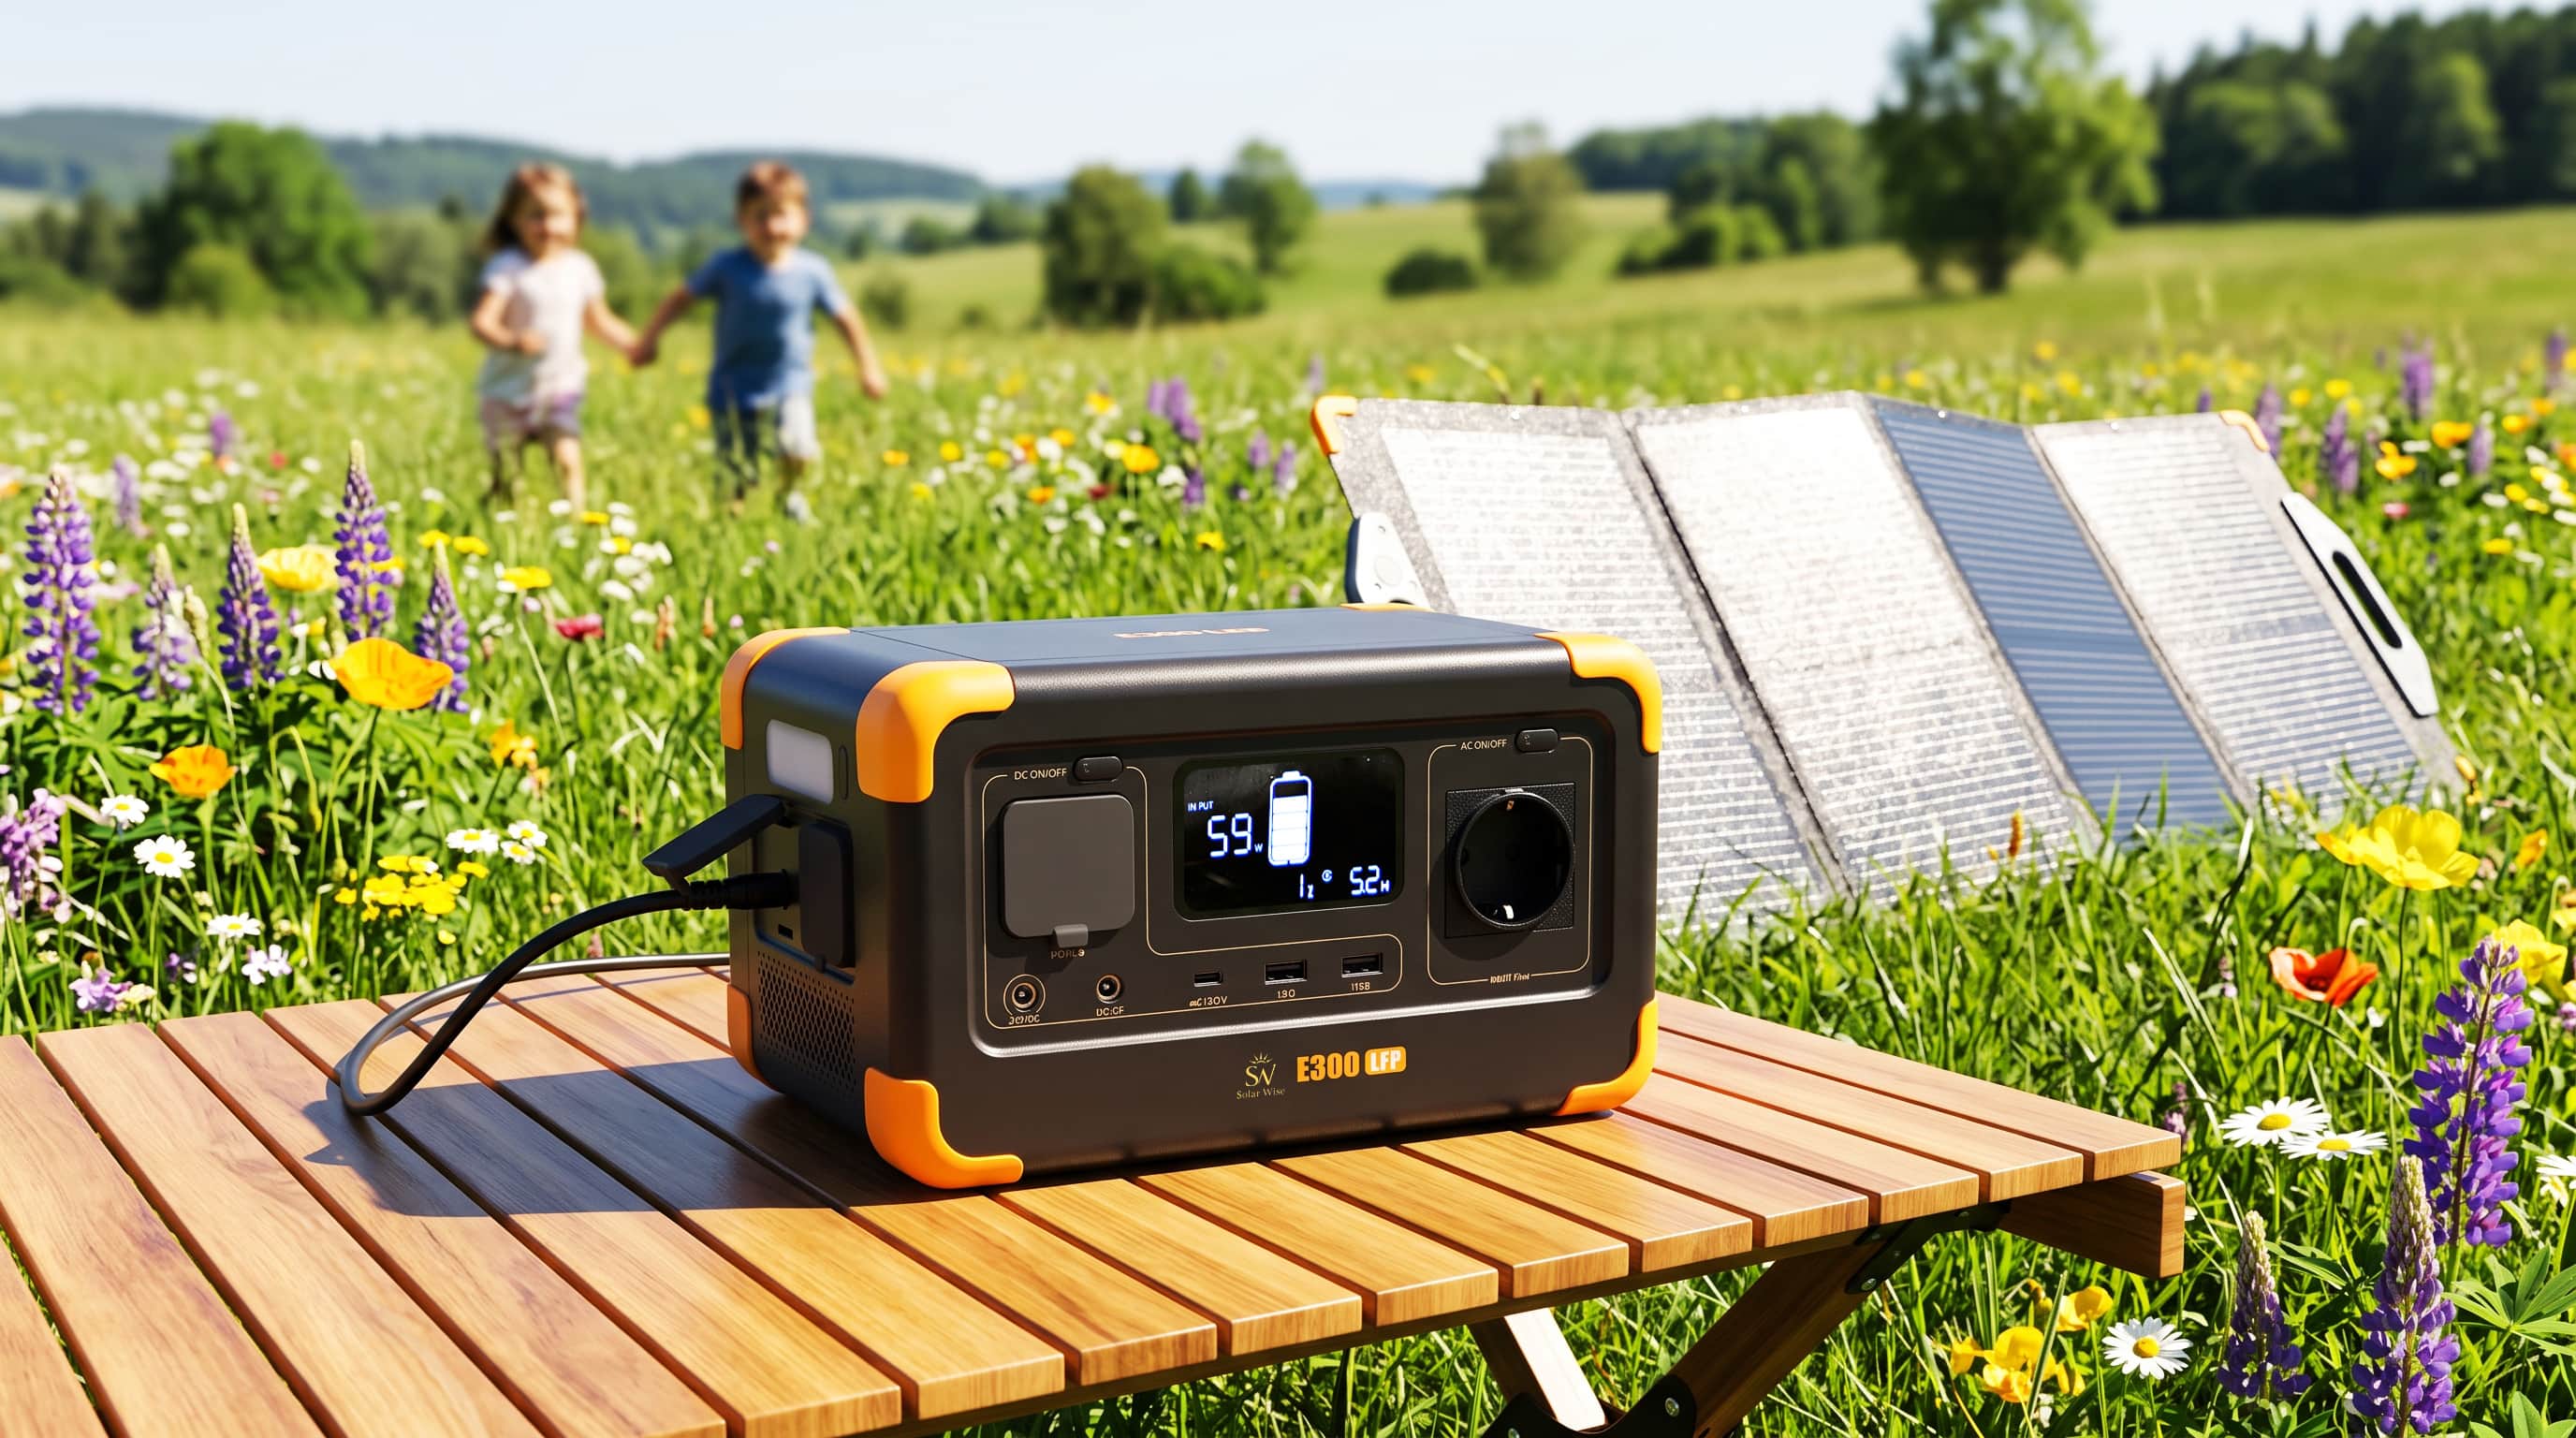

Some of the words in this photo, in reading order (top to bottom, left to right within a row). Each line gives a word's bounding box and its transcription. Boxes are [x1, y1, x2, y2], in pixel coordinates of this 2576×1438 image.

[1460, 741, 1472, 750] AC
[1474, 739, 1507, 750] ON/OFF
[1014, 770, 1029, 780] DC
[1030, 768, 1067, 779] ON/OFF
[1296, 1050, 1360, 1083] E300
[1369, 1049, 1402, 1072] LFP
[1236, 1088, 1260, 1100] Solar
[1262, 1087, 1286, 1097] Wise
